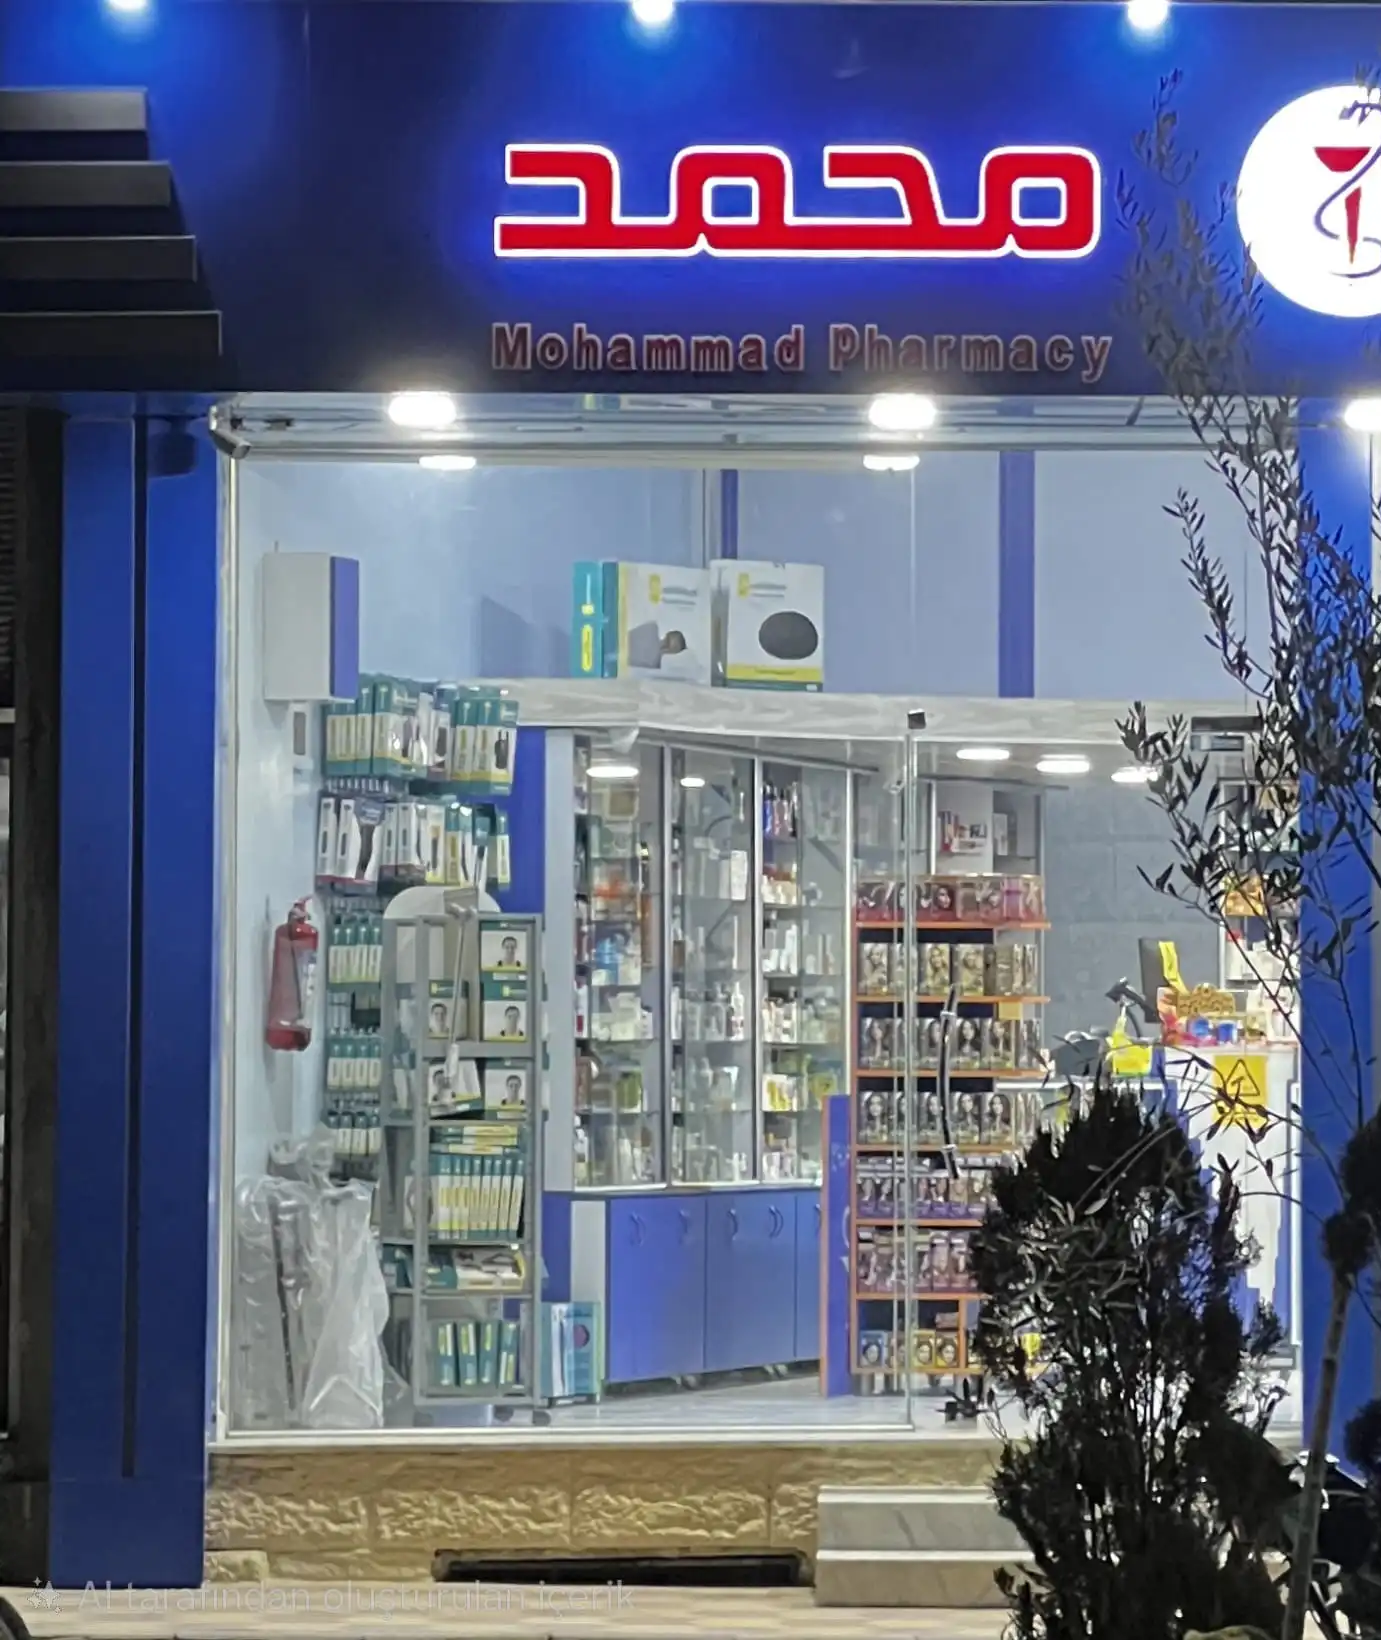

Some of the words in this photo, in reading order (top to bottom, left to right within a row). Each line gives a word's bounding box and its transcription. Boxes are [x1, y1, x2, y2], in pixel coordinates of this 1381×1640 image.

[494, 143, 1101, 260] محمد
[492, 322, 805, 372] Mohammad
[829, 323, 1113, 384] Pharmacy
